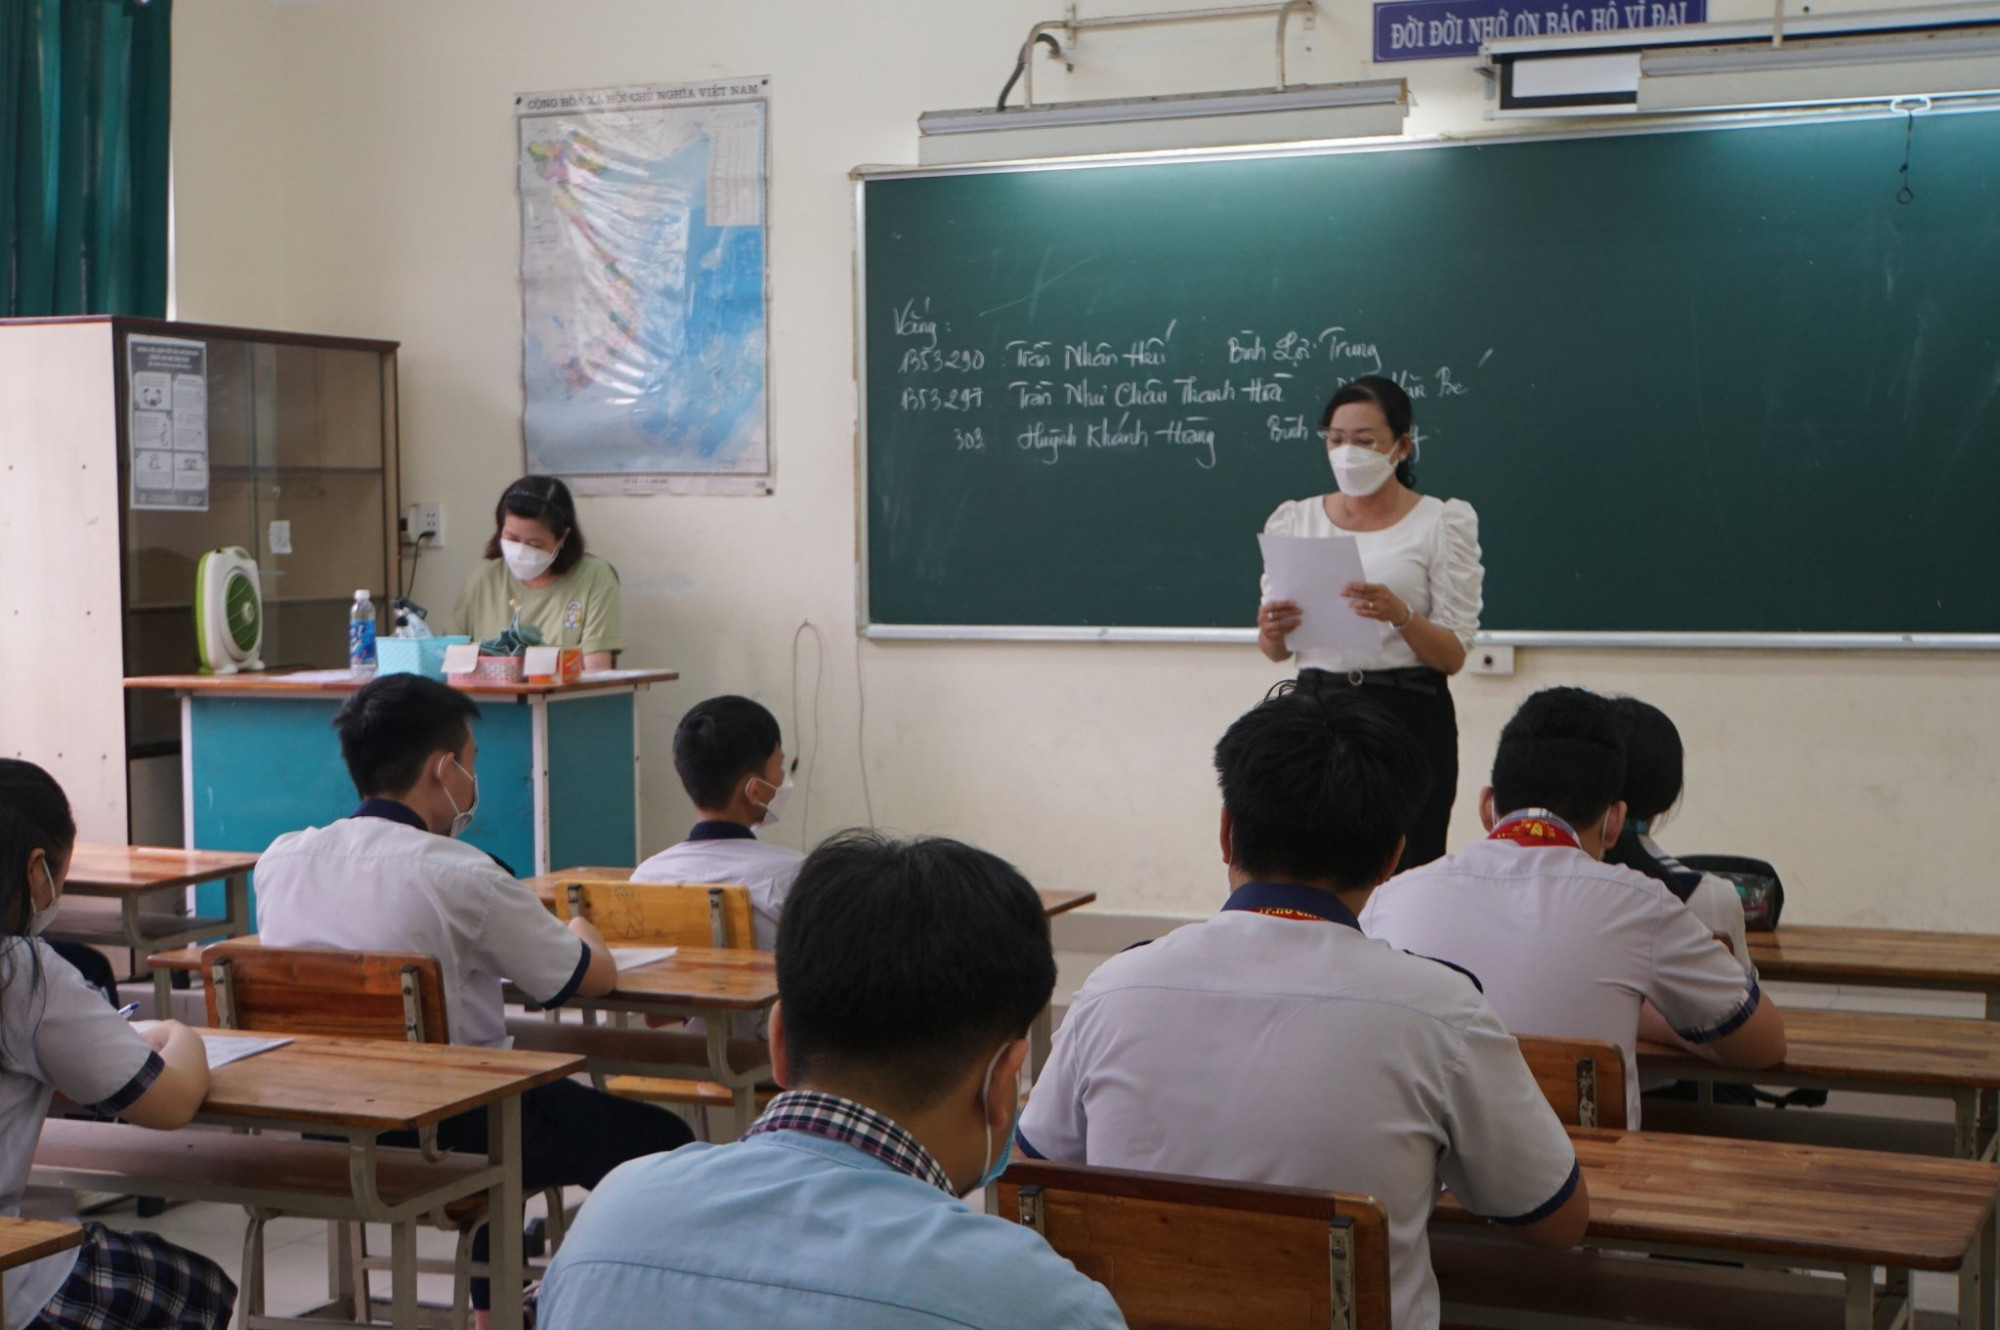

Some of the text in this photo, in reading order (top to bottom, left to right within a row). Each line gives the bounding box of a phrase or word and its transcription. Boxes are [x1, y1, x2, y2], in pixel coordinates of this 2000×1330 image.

[1391, 14, 1425, 49] ĐỜI
[1429, 12, 1463, 46] ĐỜI
[1545, 4, 1585, 34] BÁC
[698, 84, 728, 98] VIỆT
[731, 84, 759, 95] NAM
